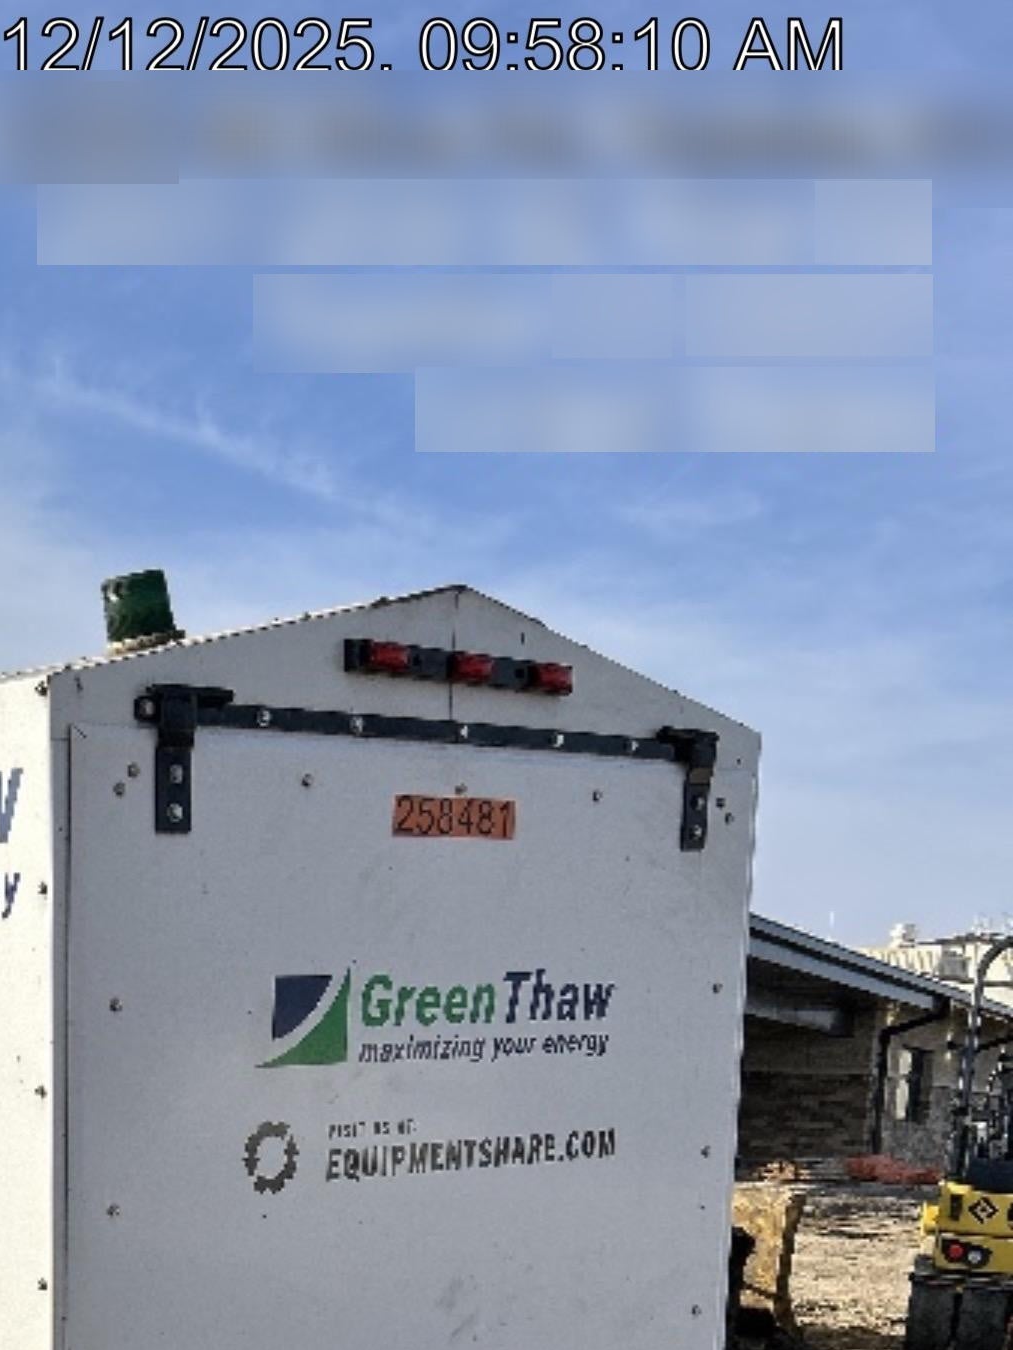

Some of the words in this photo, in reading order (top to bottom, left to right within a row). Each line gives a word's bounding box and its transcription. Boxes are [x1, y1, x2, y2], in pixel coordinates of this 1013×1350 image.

[396, 795, 511, 838] 258481
[358, 1034, 486, 1063] maximizing
[491, 1036, 537, 1062] your
[541, 1034, 610, 1057] energy
[325, 1128, 617, 1183] EQUIPMENTSHARE.COM
